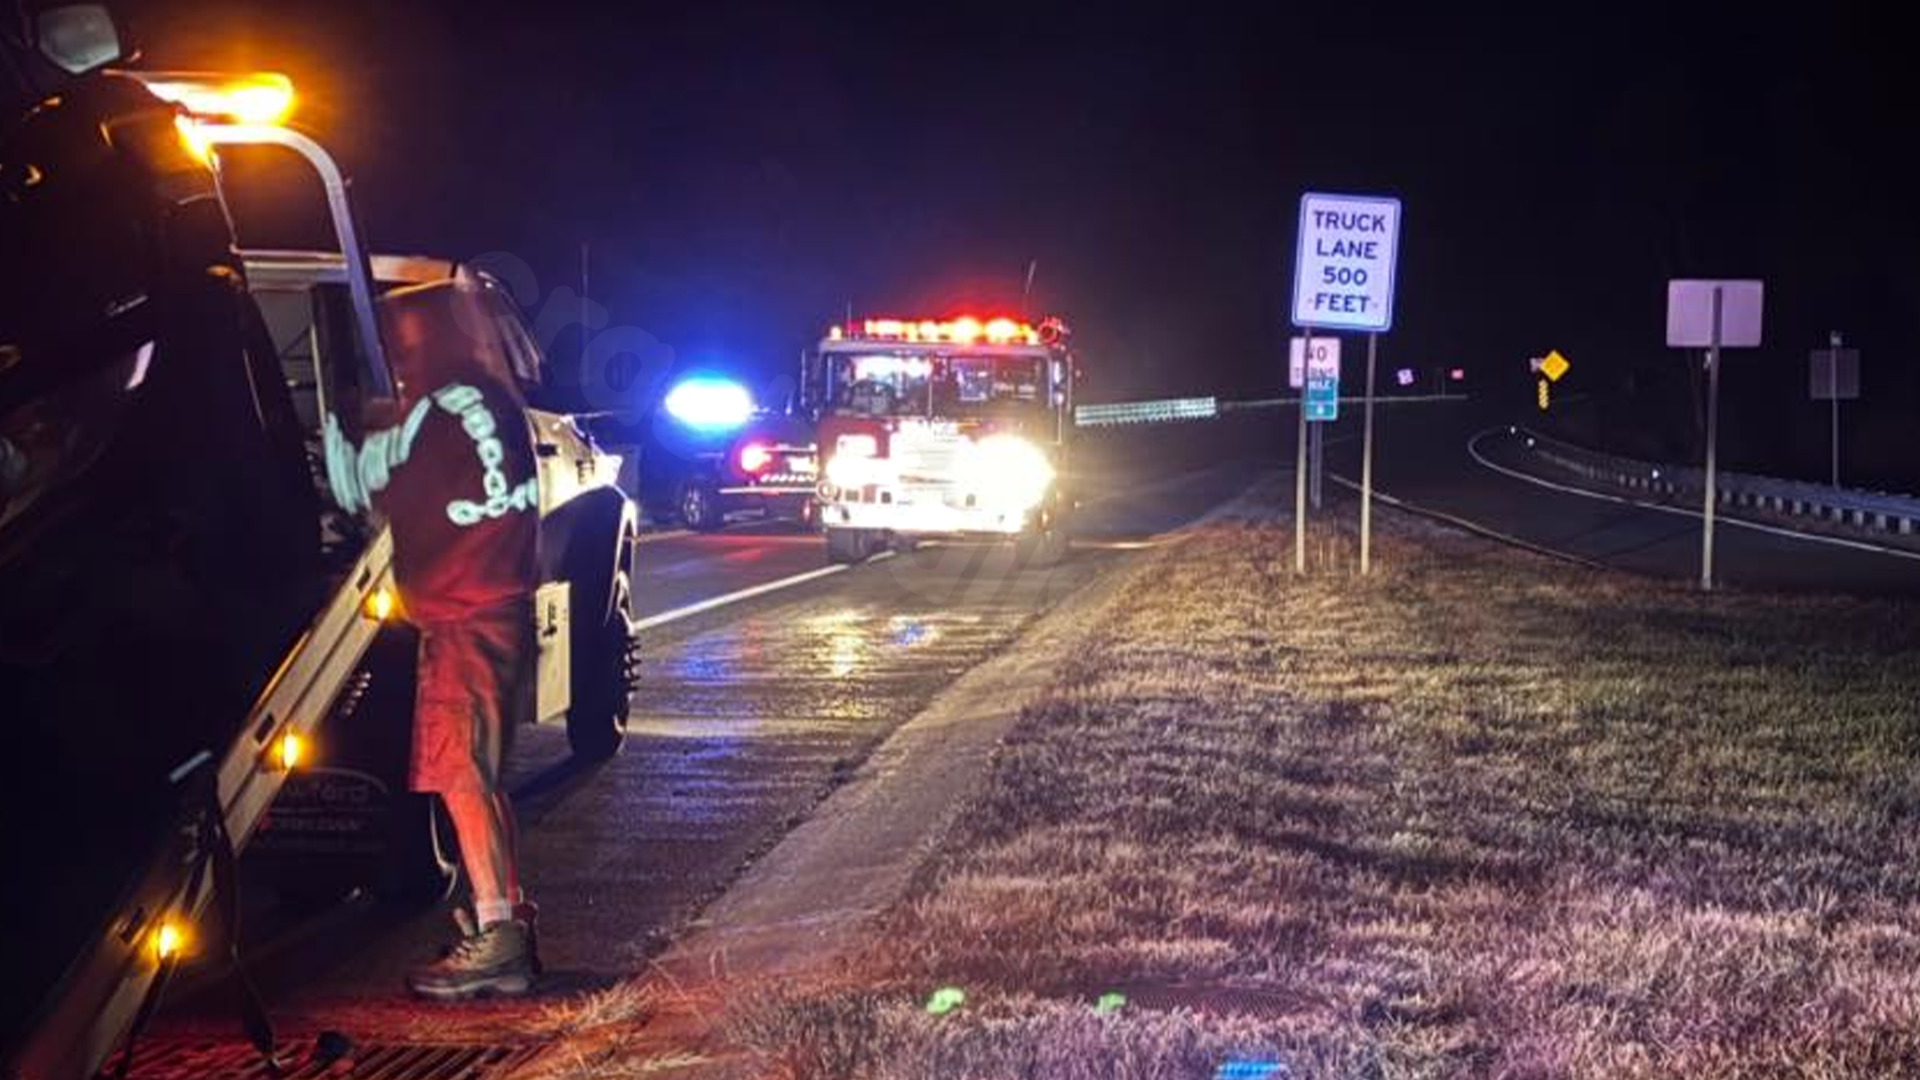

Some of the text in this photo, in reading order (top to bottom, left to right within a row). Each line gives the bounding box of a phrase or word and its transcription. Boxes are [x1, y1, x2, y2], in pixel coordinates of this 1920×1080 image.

[1312, 210, 1386, 232] TRUCK
[1316, 238, 1378, 260] LANE
[1323, 266, 1367, 285] 500
[1314, 293, 1371, 313] FEET
